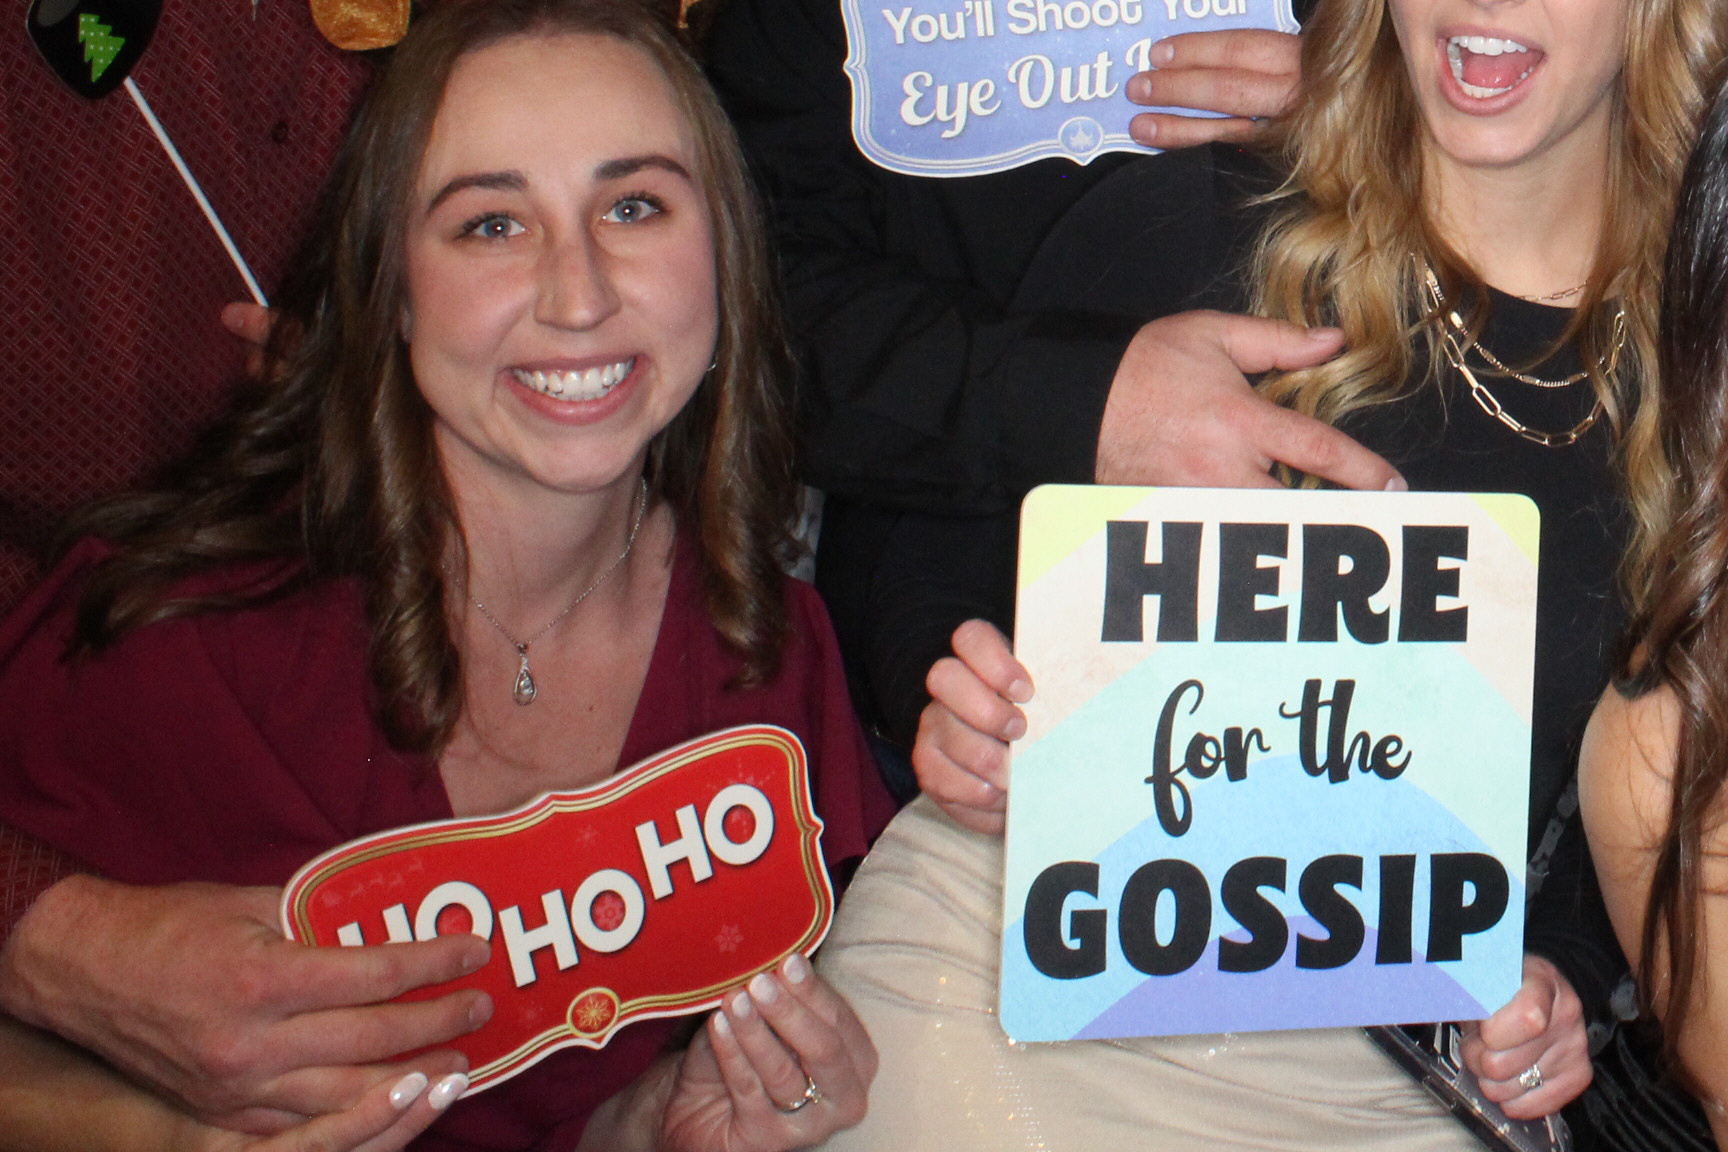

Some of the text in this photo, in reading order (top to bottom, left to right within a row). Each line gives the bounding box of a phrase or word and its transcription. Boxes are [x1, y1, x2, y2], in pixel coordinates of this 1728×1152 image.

[882, 0, 996, 45] You'll
[899, 71, 1001, 139] Eye
[1007, 50, 1120, 108] Out
[1100, 520, 1469, 645] HERE
[1144, 678, 1412, 837] for the
[1022, 852, 1510, 980] GOSSIP
